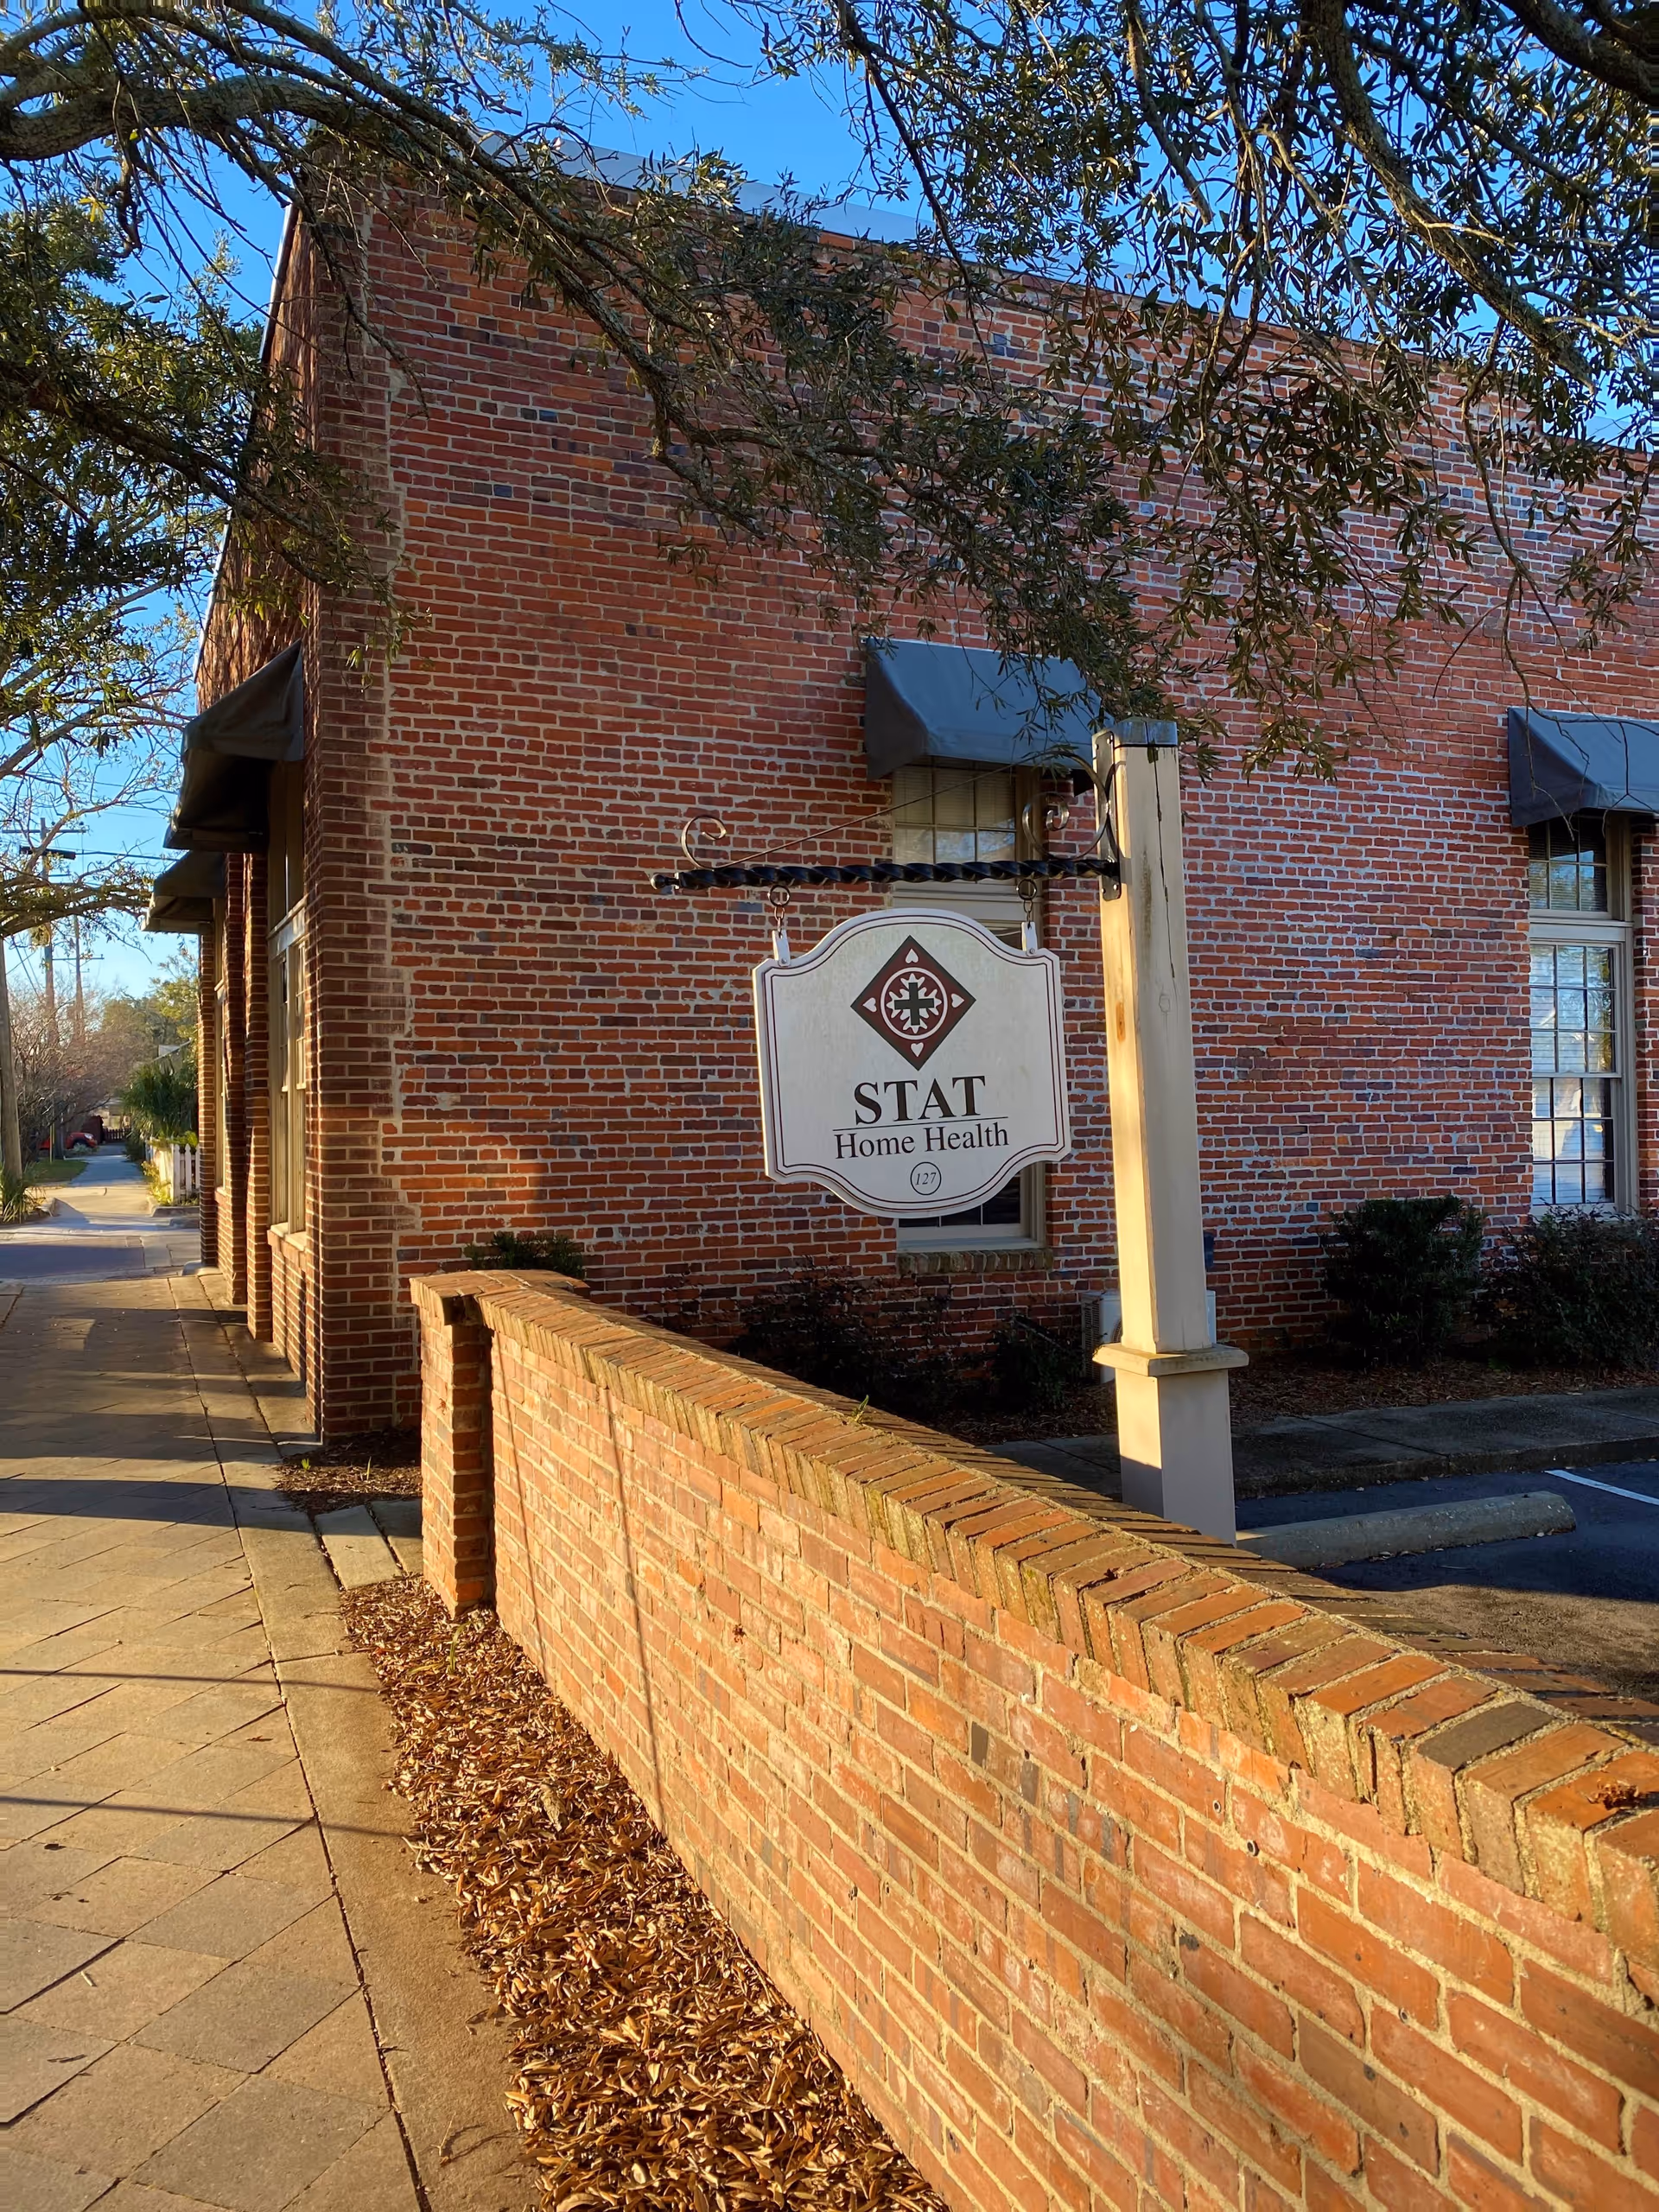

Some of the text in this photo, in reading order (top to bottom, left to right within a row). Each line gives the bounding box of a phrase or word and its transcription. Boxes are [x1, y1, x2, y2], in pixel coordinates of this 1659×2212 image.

[854, 1075, 986, 1125] STAT
[835, 1122, 1009, 1160] Home Health
[915, 1172, 938, 1186] 127
